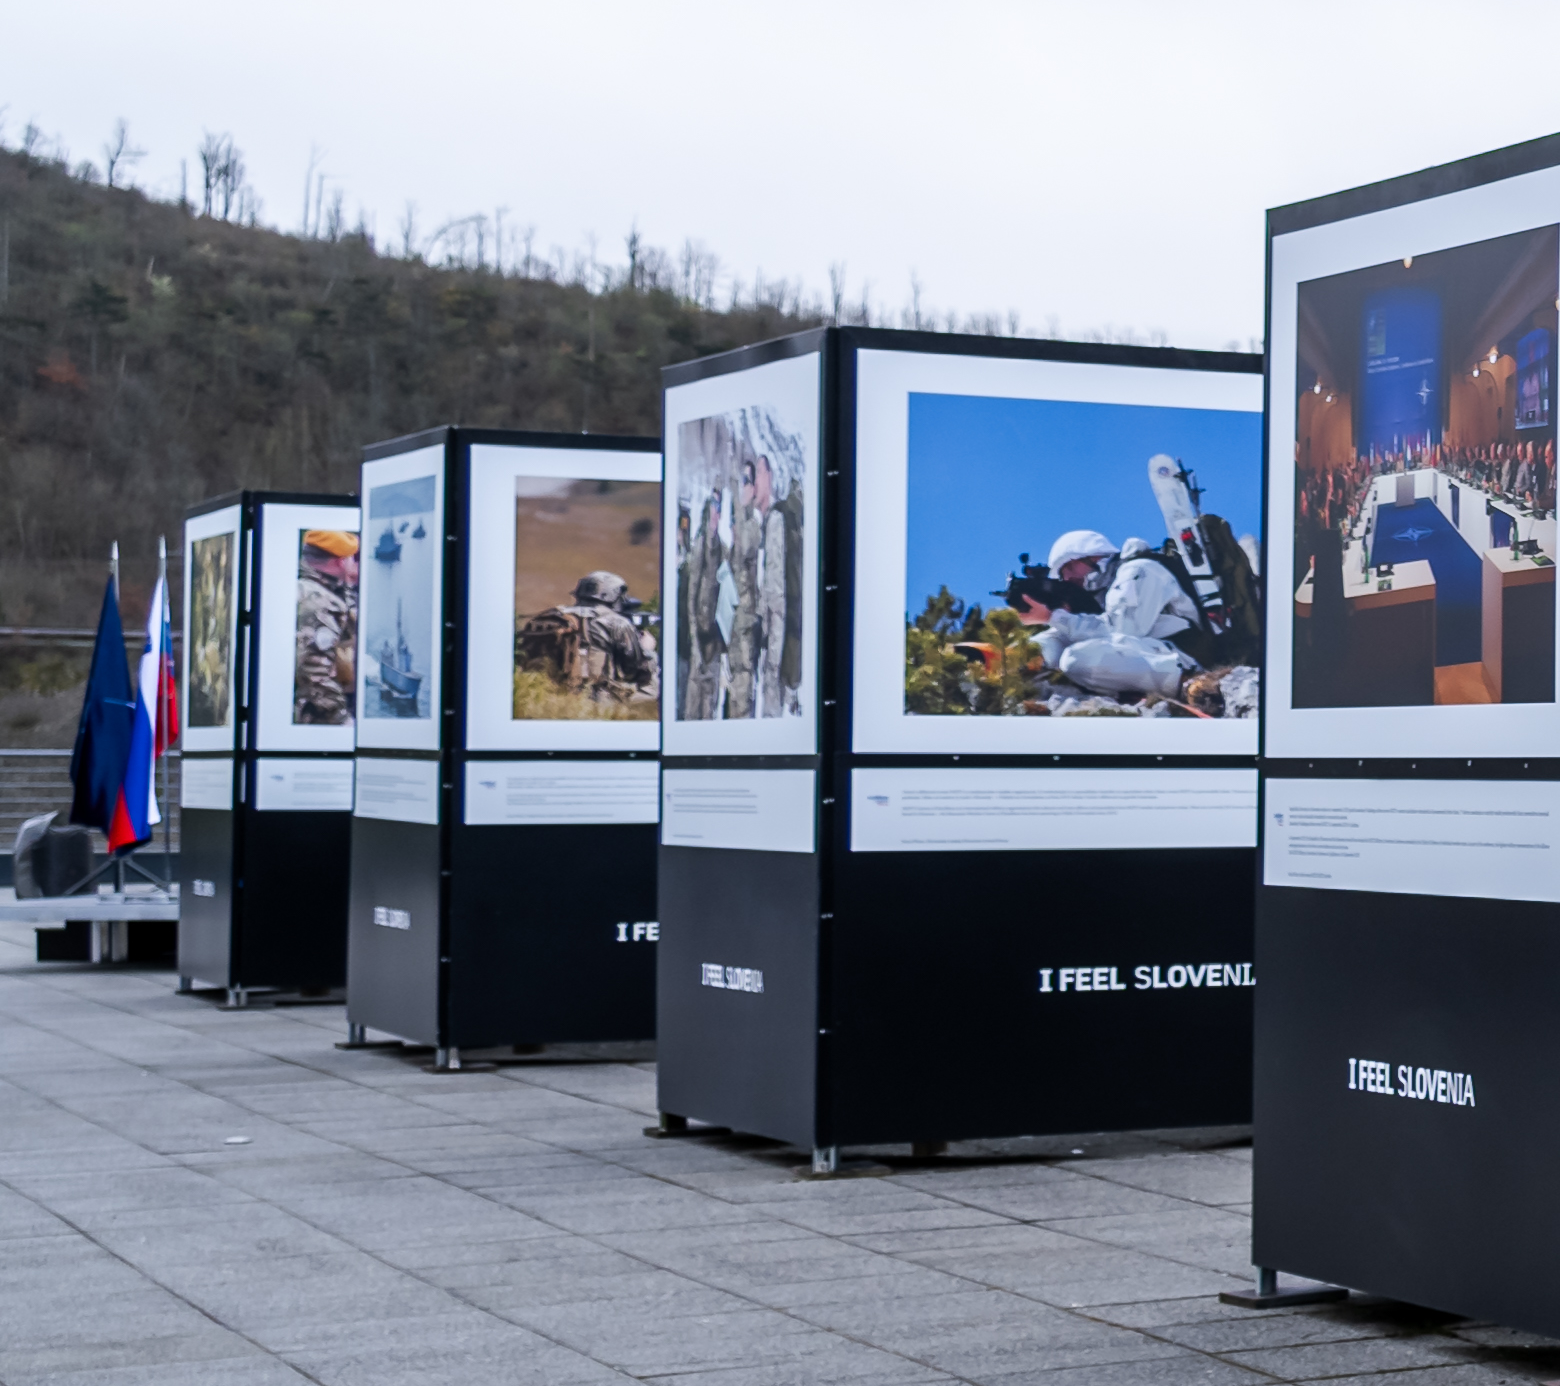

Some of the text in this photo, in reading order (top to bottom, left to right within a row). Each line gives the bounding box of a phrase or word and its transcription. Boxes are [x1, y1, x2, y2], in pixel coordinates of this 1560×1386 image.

[616, 922, 628, 941] I
[1039, 963, 1256, 992] I FEEL SLOVENI
[1349, 1058, 1475, 1107] I FEEL SLOVENIA
